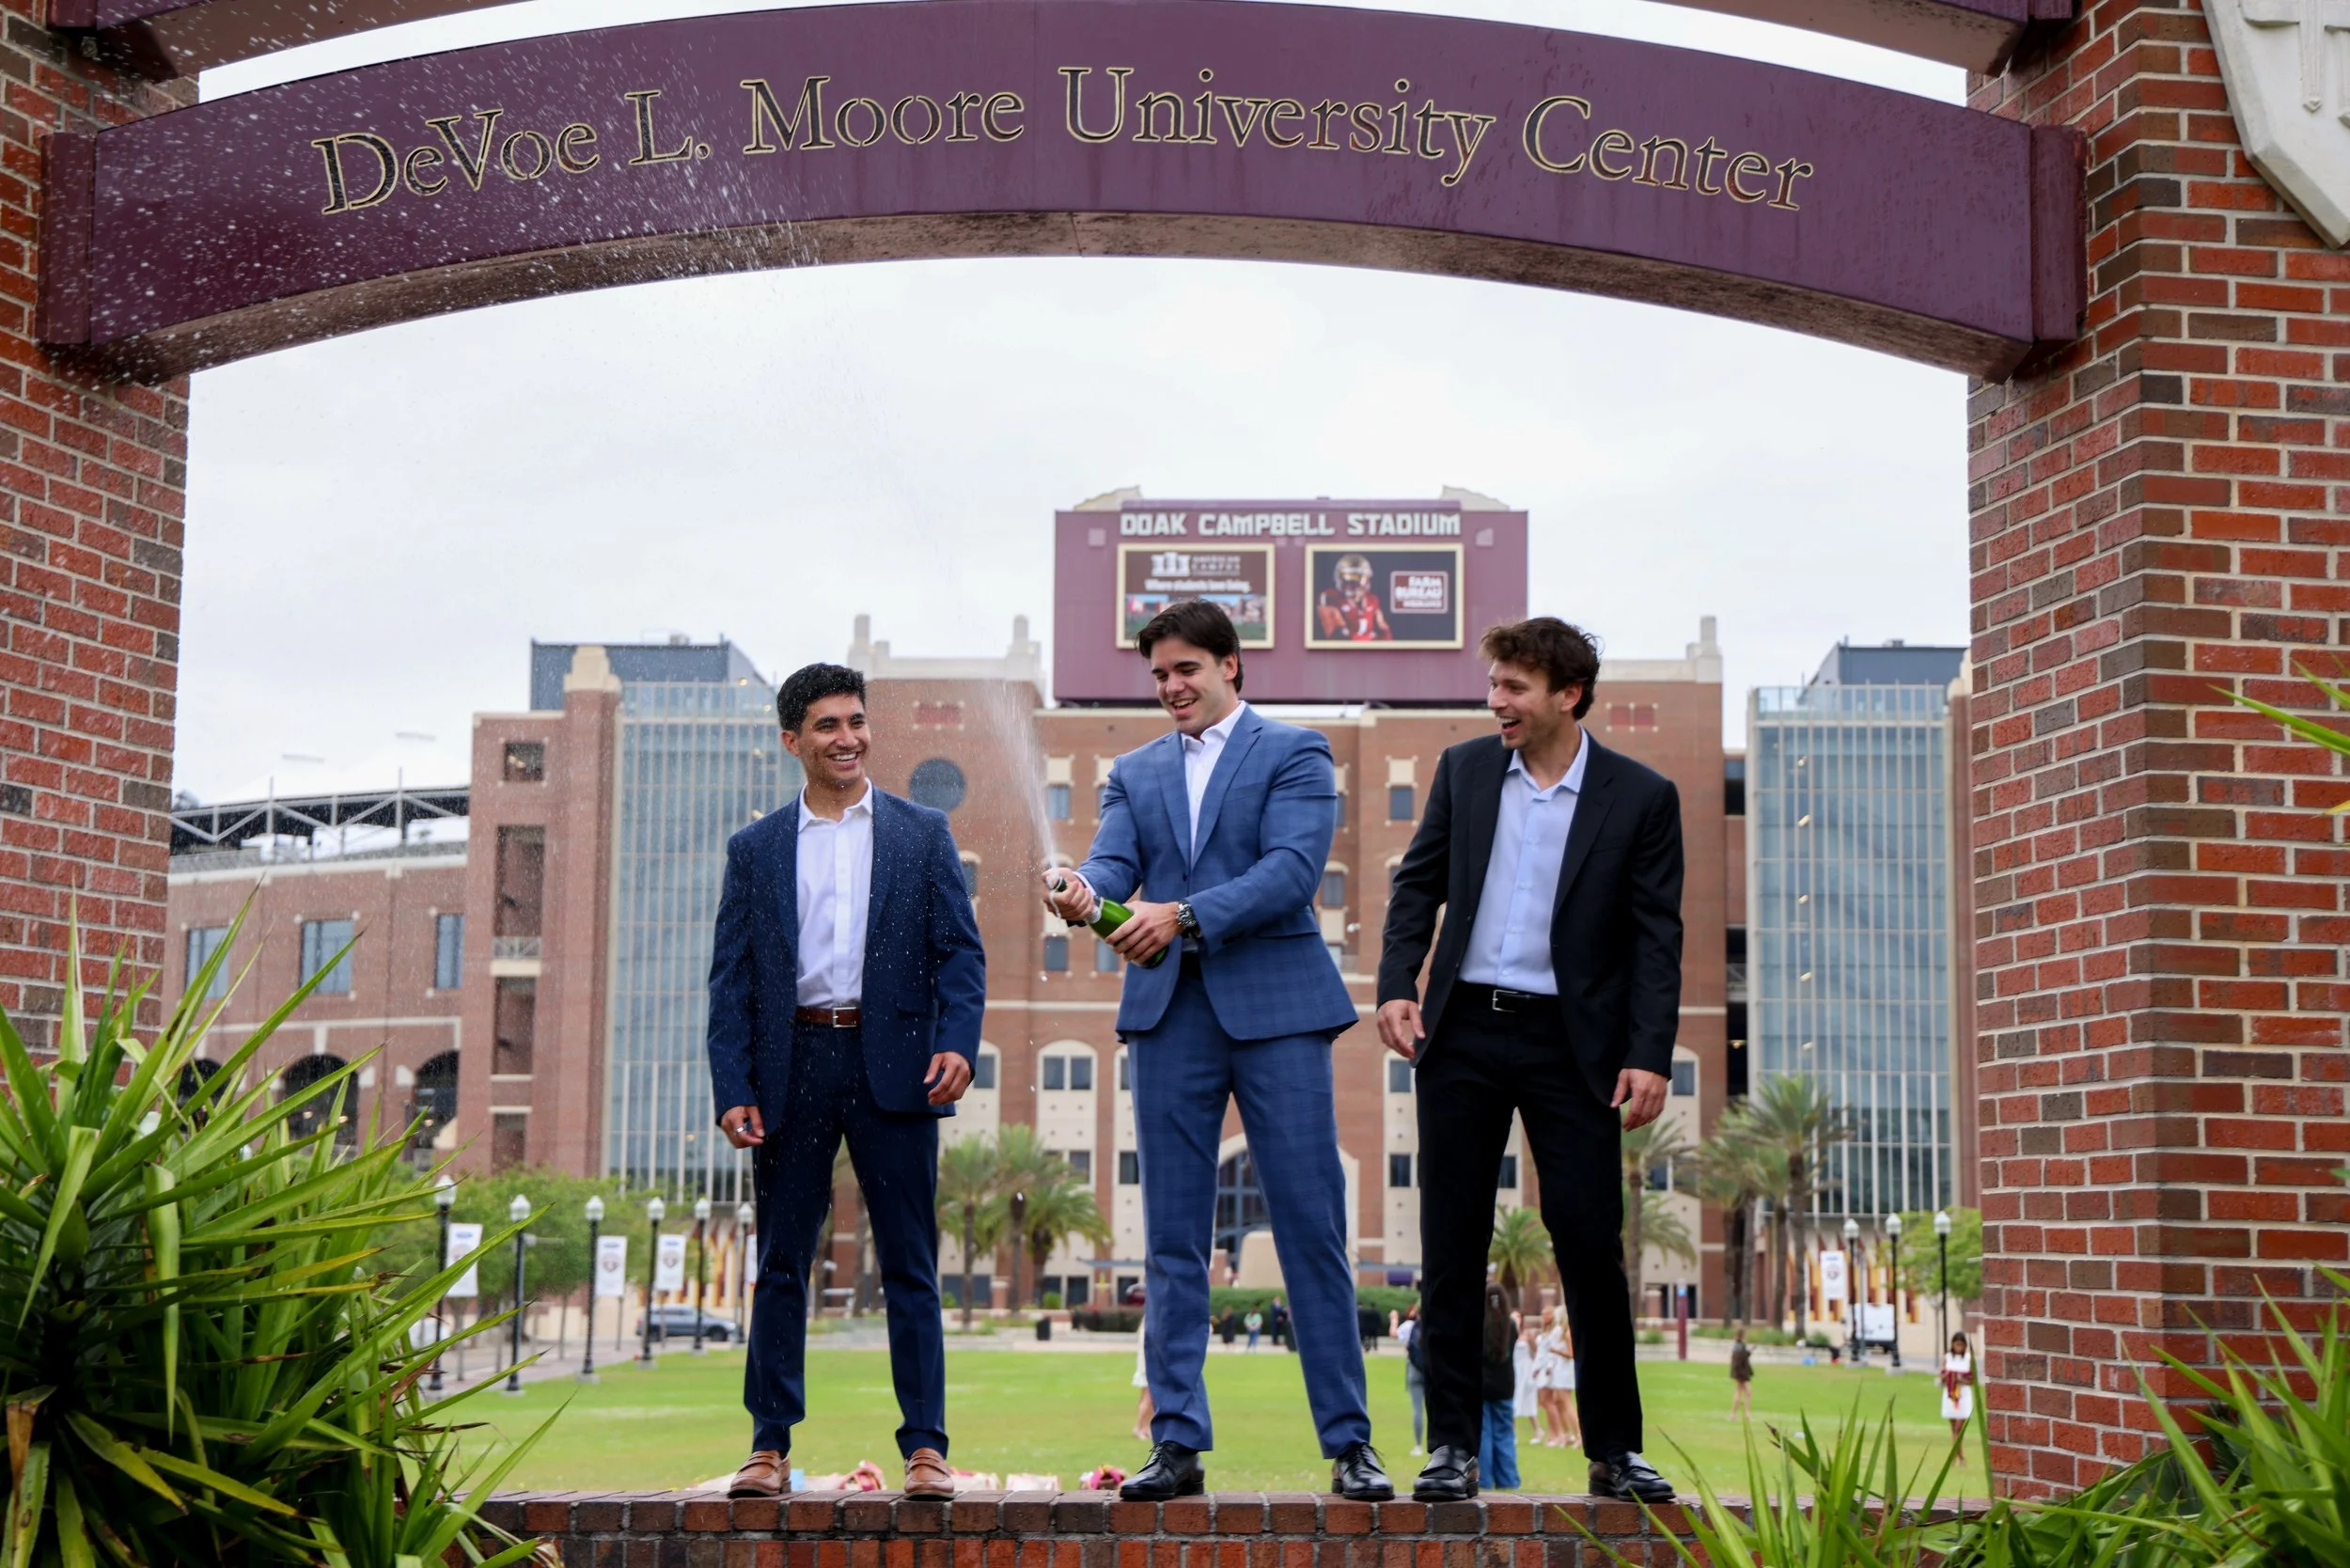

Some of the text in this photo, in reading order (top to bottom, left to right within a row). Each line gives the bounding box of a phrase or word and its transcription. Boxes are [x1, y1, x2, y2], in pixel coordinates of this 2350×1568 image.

[311, 66, 1815, 215] DeVoe L. Moore University Center
[1120, 512, 1462, 537] DOAK CAMPBELL STADIUM
